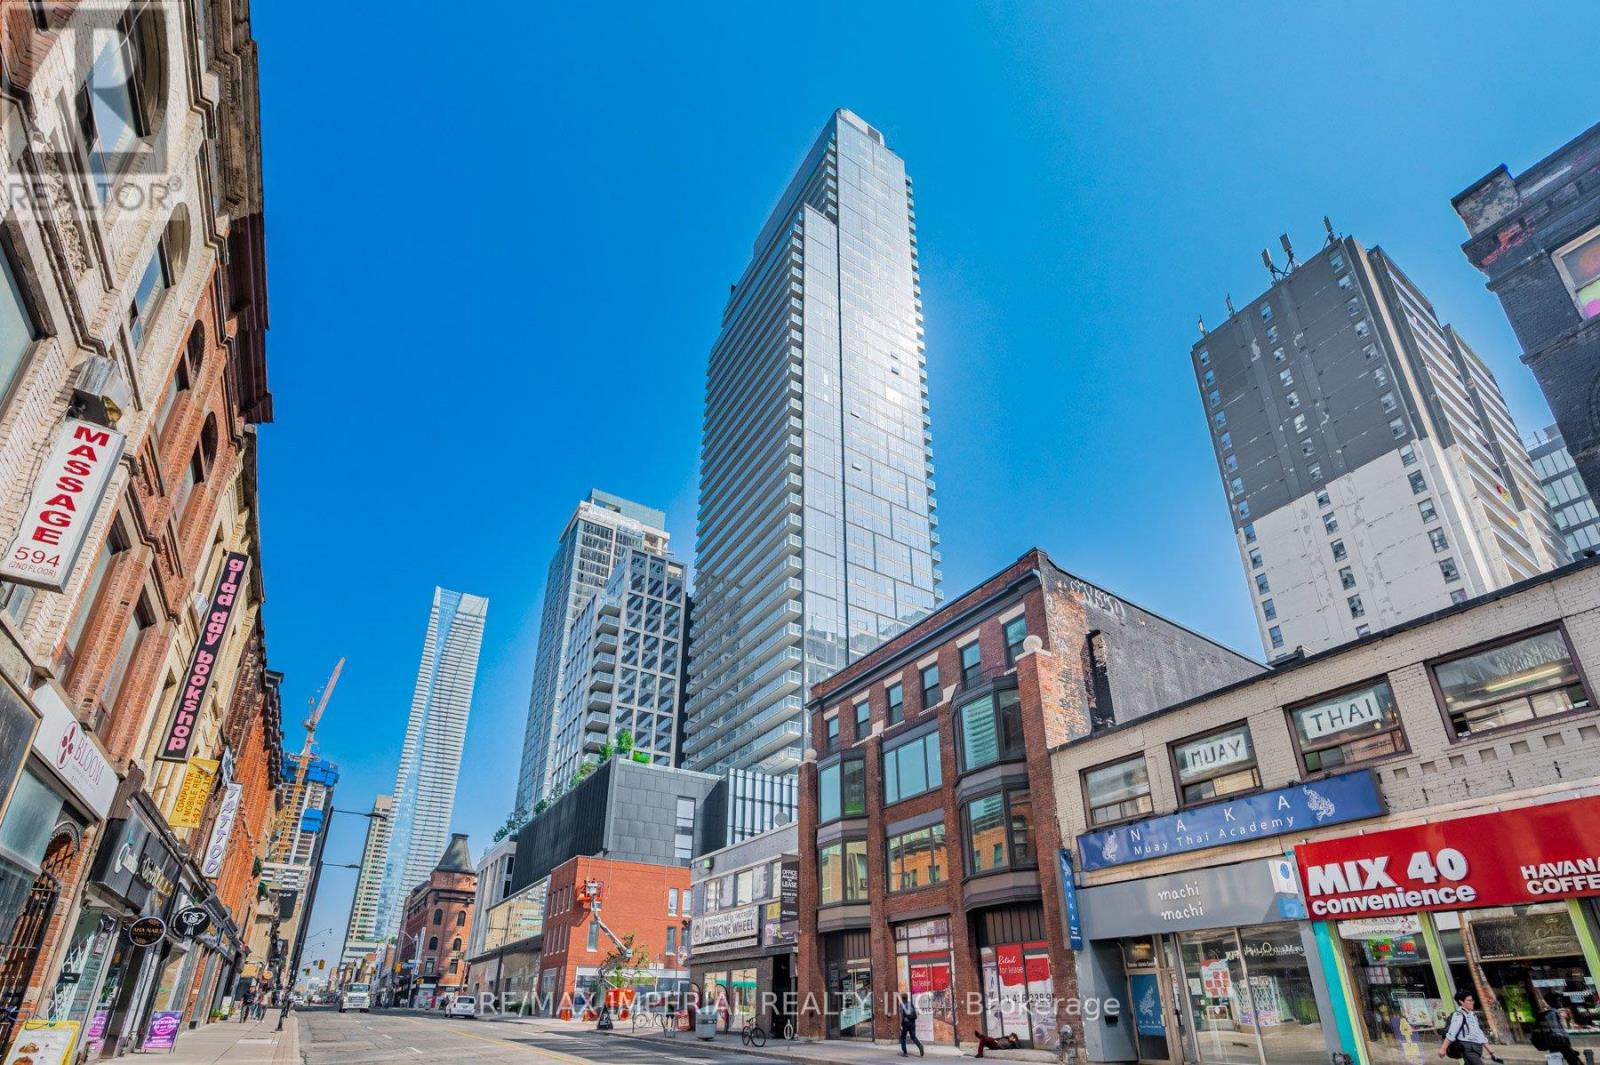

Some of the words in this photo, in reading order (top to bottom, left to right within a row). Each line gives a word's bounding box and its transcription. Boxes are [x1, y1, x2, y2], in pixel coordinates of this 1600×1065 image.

[32, 426, 110, 546] MASSAGE
[15, 546, 60, 568] 594
[217, 558, 244, 607] glad
[205, 611, 228, 646] day
[168, 650, 214, 751] bookshop
[1309, 698, 1375, 732] THAI
[1190, 739, 1241, 767] MUAY
[205, 785, 239, 875] TATTOO
[1131, 795, 1290, 842] NAKA
[1134, 841, 1169, 855] Muay
[1176, 831, 1209, 846] Thai
[1219, 815, 1295, 839] Academy
[1307, 856, 1398, 898] MIX
[1406, 847, 1469, 884] 40
[1520, 856, 1600, 880] HAVAN
[1158, 881, 1200, 901] machi
[1311, 884, 1477, 916] convenience
[1161, 901, 1204, 921] machi
